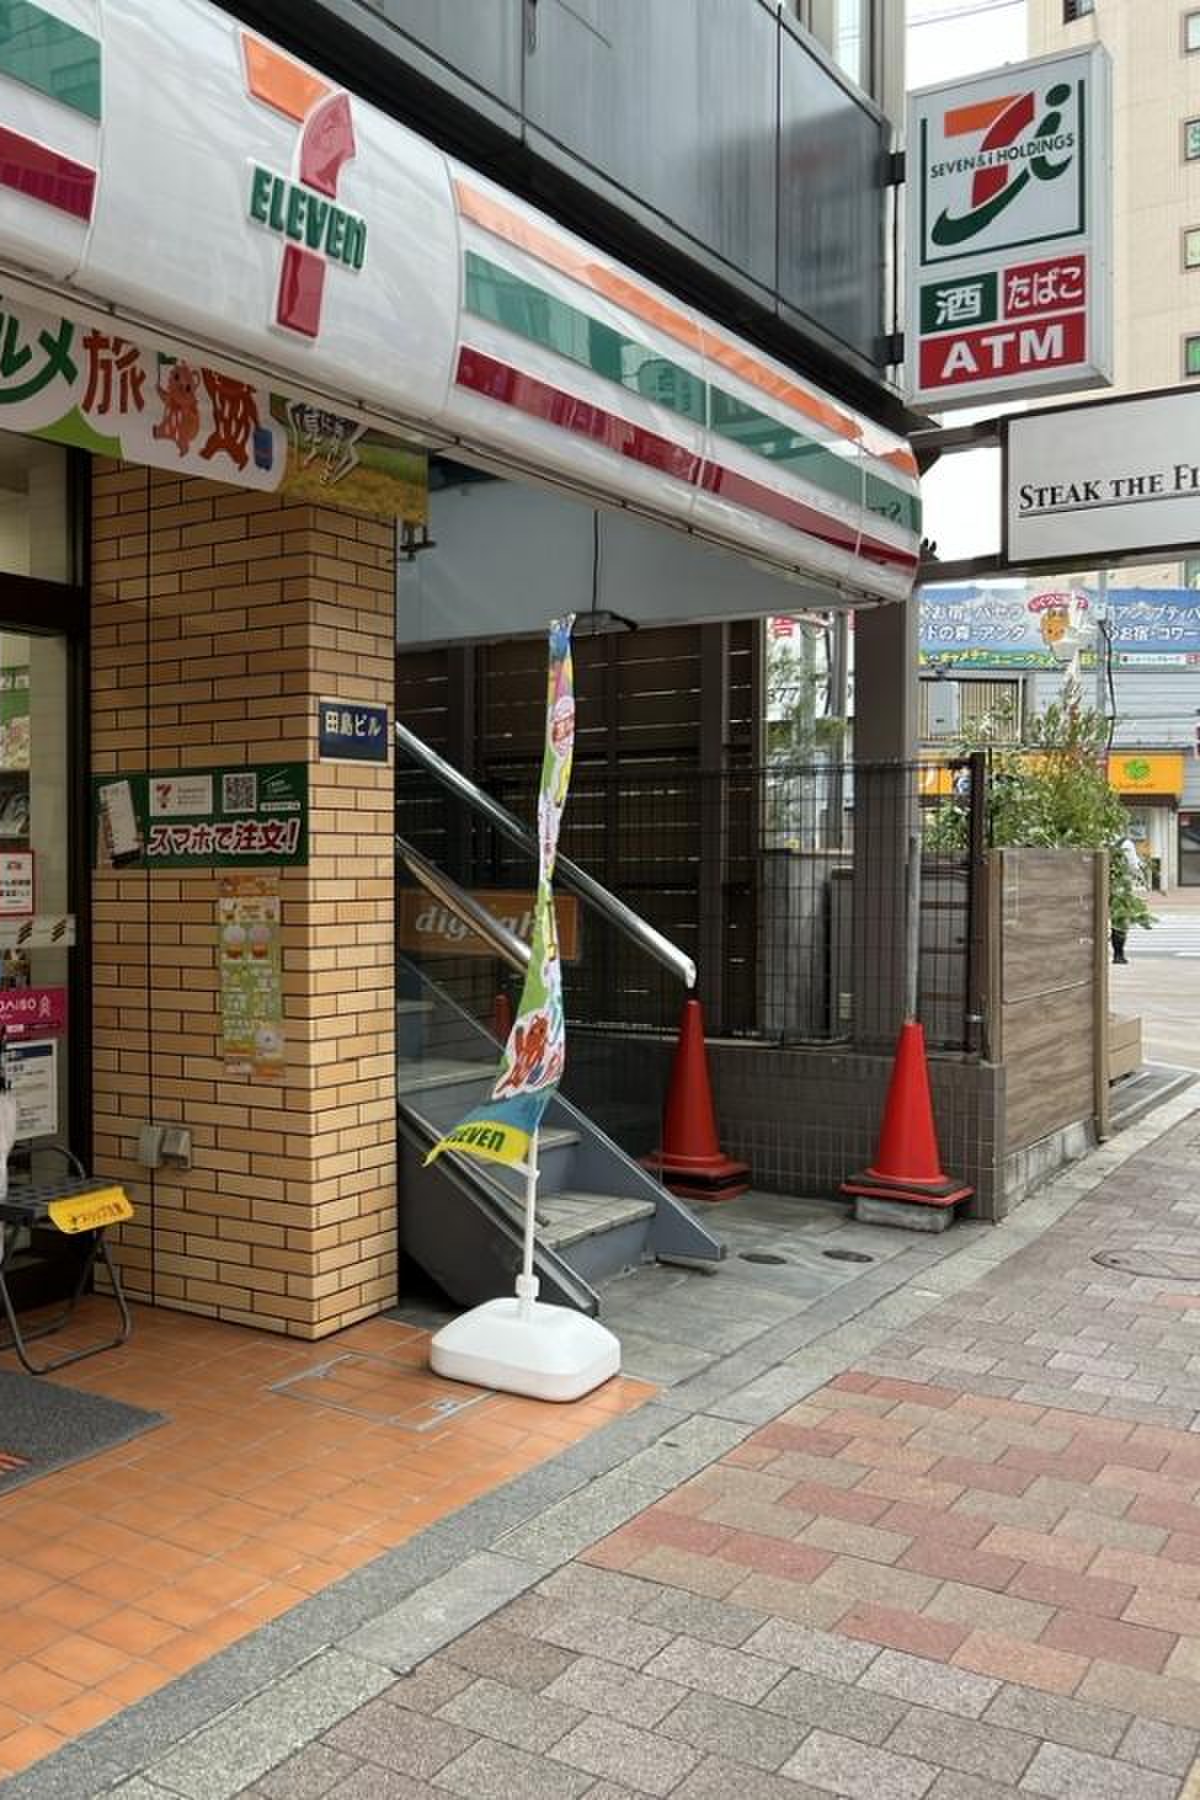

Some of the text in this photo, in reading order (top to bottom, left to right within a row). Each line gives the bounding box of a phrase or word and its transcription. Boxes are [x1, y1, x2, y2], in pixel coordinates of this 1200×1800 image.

[996, 133, 1075, 163] HOLDINGS
[935, 283, 984, 325] 酒
[1006, 267, 1083, 311] たばこ
[940, 324, 1064, 379] ATM
[1018, 479, 1101, 511] STEAK
[1109, 473, 1164, 498] THE
[325, 711, 382, 738] 田島ビル
